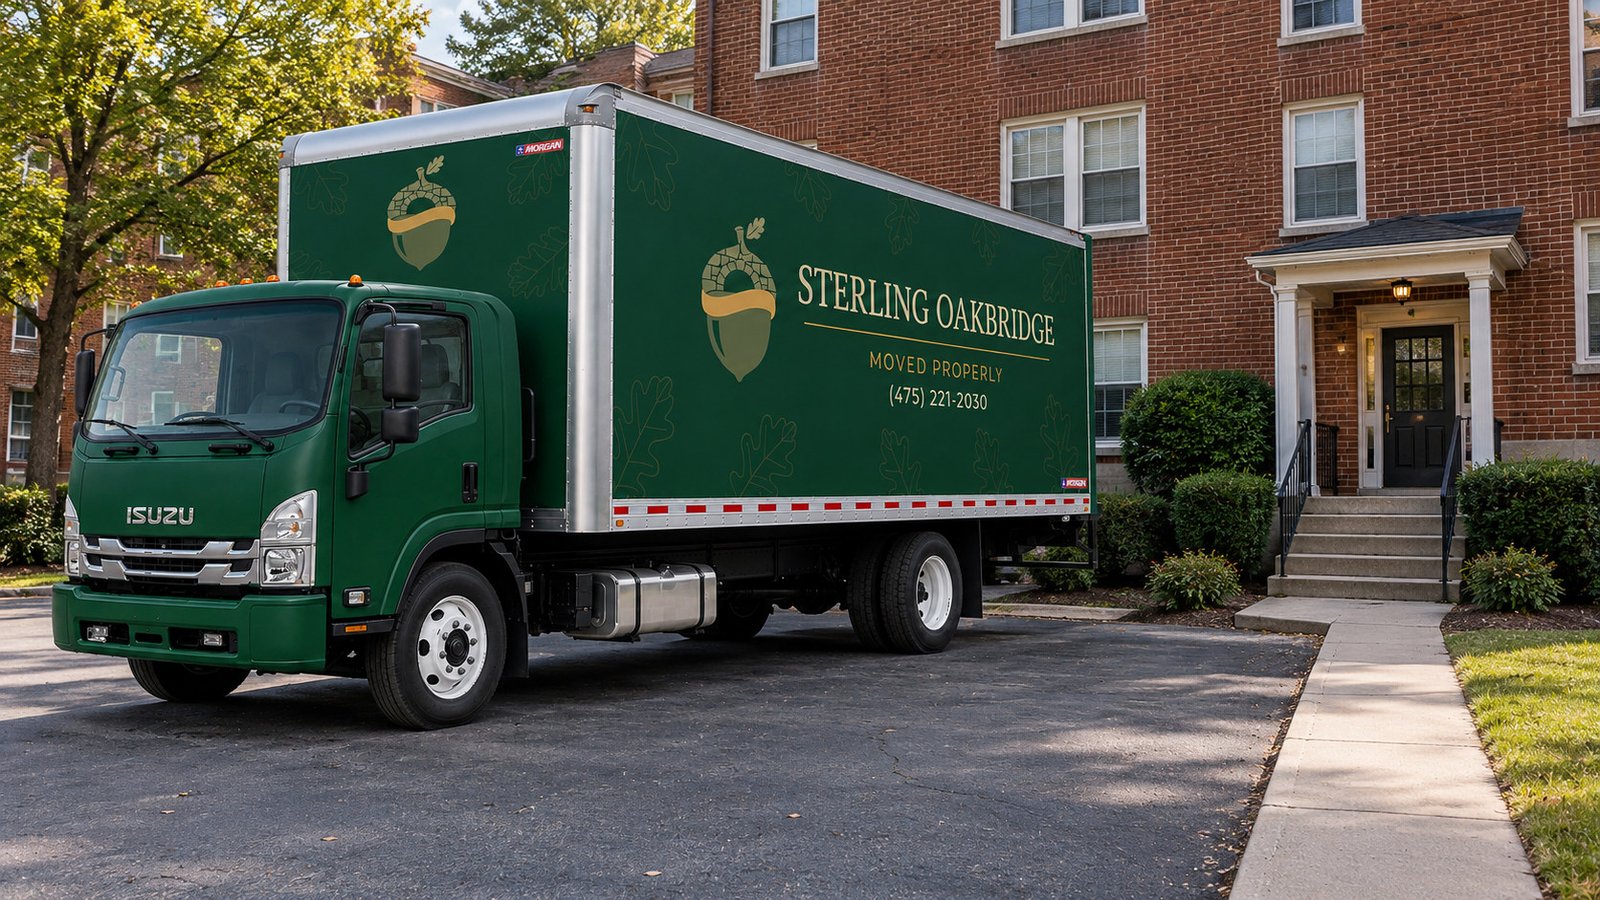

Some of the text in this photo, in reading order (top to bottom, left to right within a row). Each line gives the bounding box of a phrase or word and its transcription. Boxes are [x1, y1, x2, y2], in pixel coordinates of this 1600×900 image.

[525, 141, 562, 154] MORGAN
[798, 264, 1055, 346] STERLING OAKBRIDGE
[869, 351, 1003, 383] MOVED PROPERLY
[889, 384, 988, 410] (475) 221-2030
[126, 506, 194, 526] ISUZU
